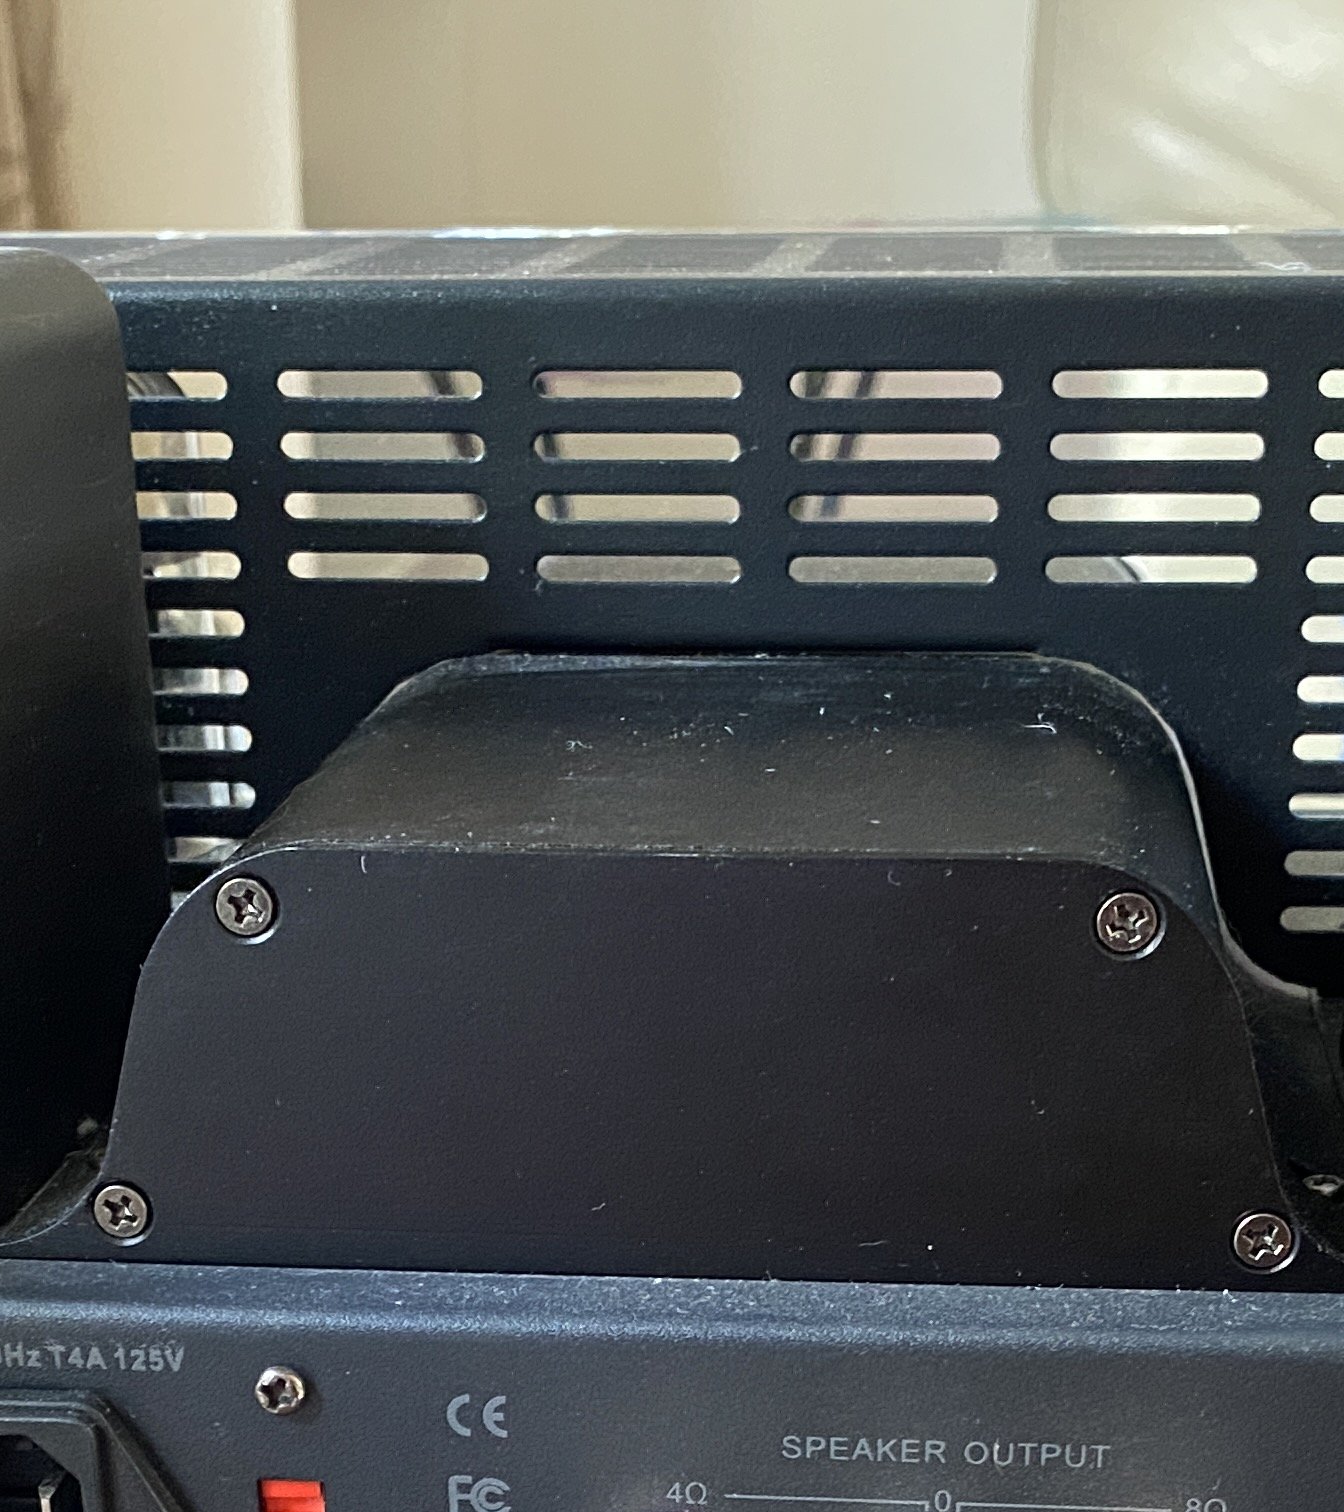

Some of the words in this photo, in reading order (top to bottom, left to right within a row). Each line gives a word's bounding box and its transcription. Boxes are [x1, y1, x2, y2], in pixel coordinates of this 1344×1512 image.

[114, 1340, 185, 1372] 125V
[781, 1435, 947, 1464] SPEAKER
[964, 1441, 1112, 1469] OUTPUT
